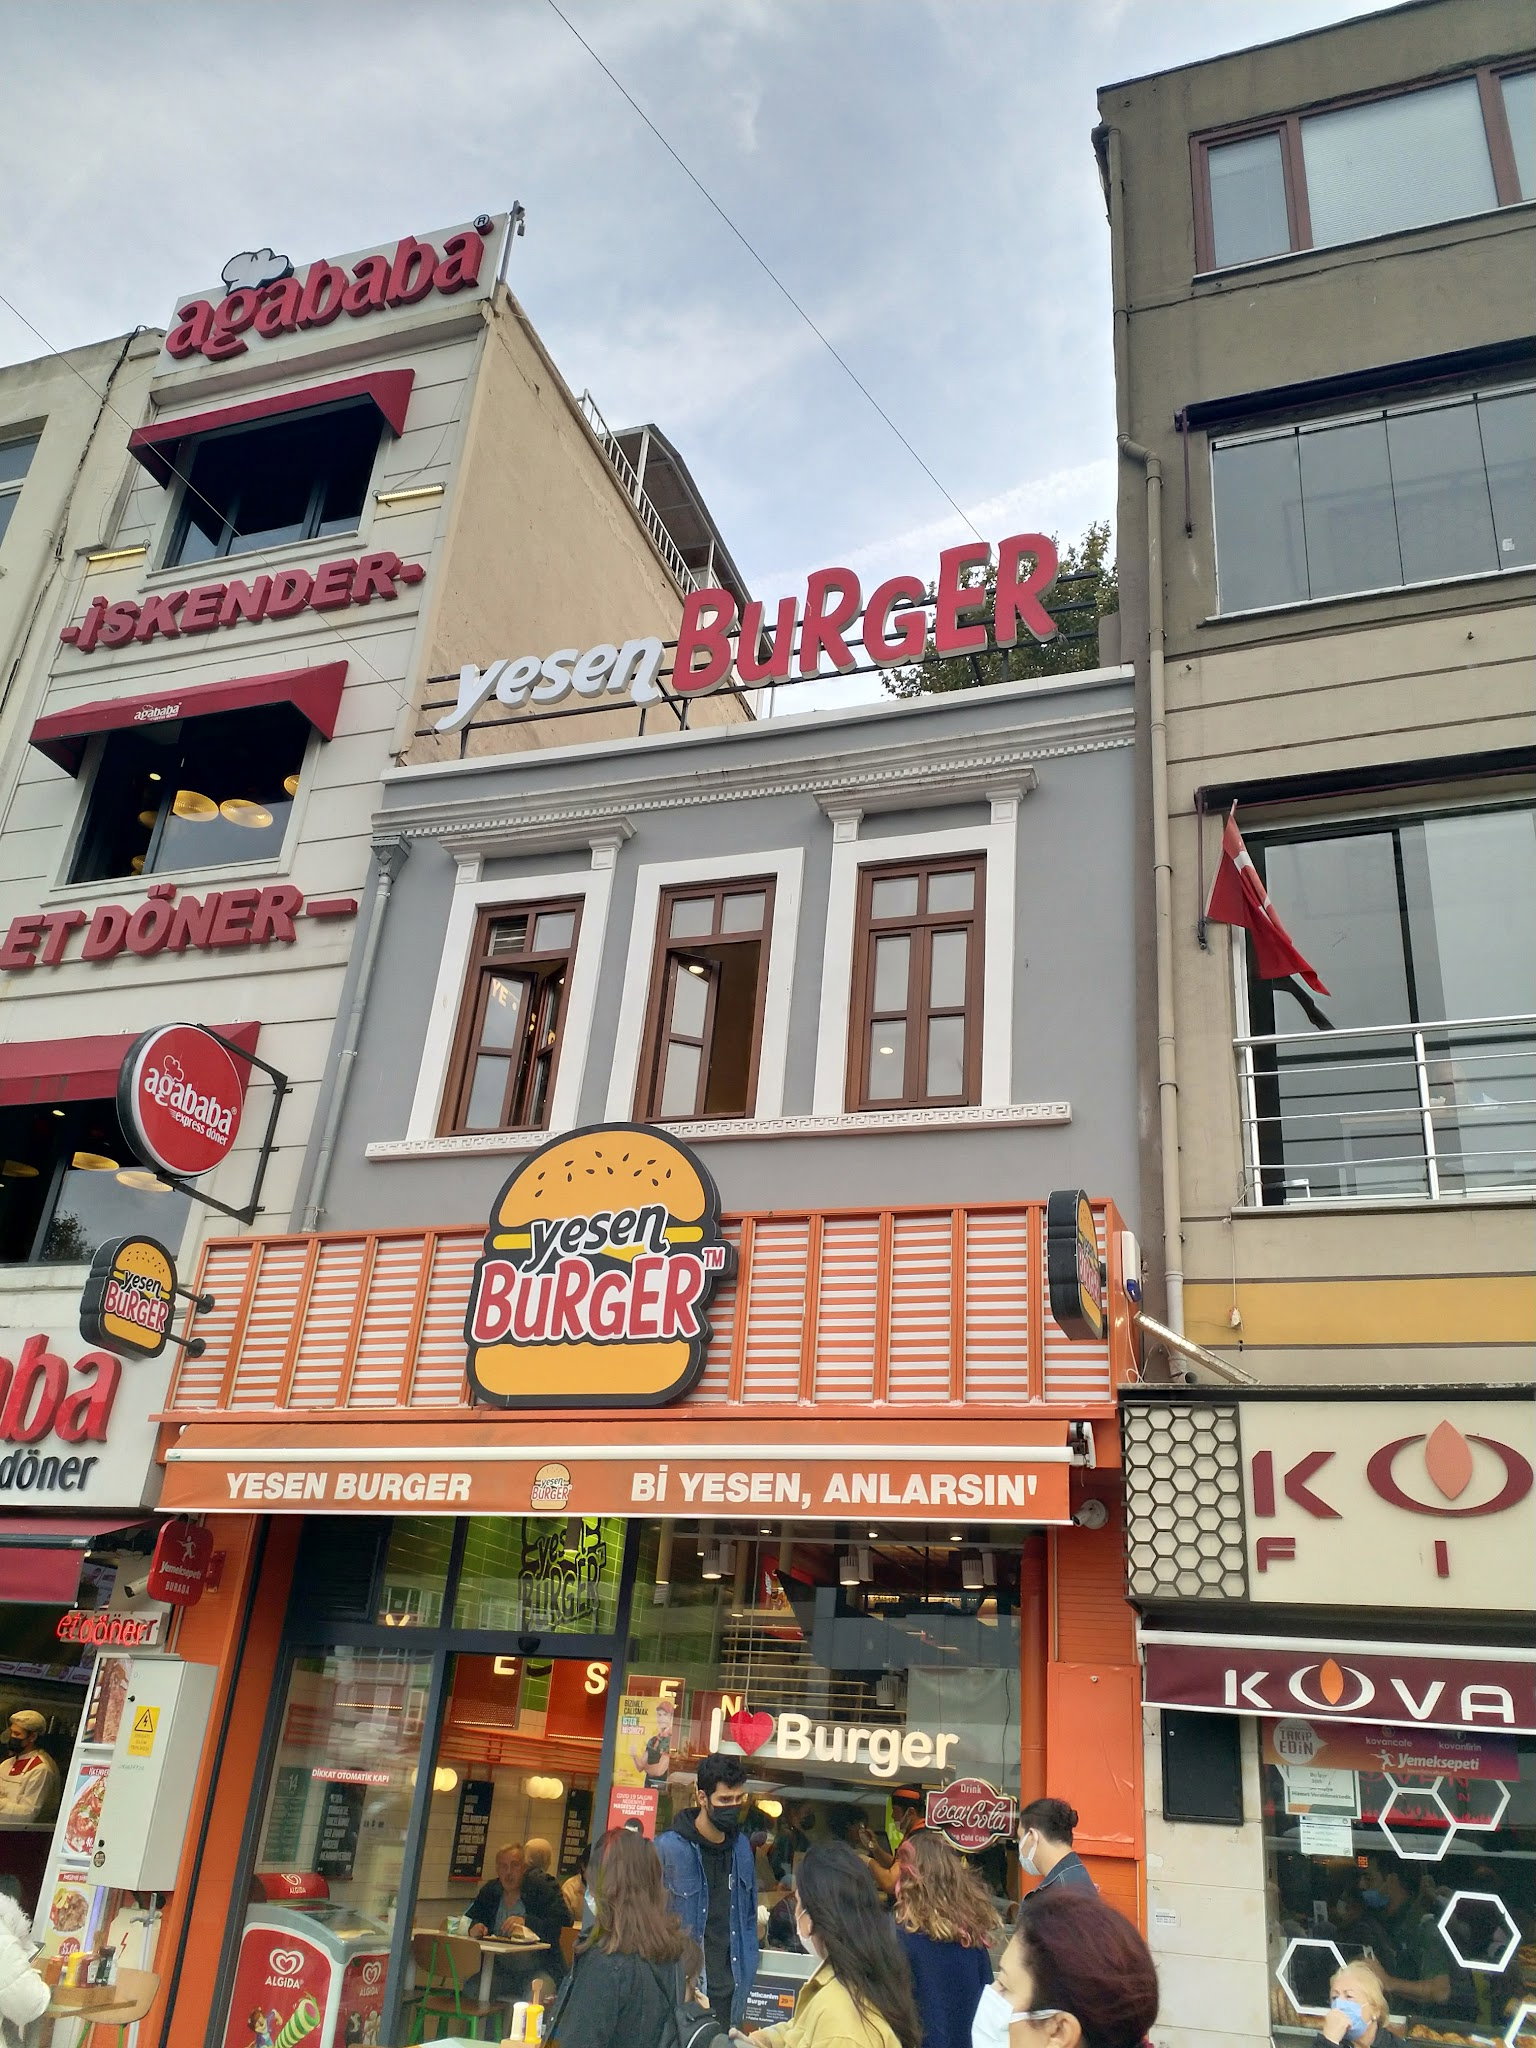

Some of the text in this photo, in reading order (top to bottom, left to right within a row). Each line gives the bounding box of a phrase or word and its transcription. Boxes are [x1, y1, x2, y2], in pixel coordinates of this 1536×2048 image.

[166, 229, 486, 361] agababa
[435, 534, 1059, 734] yesen BURGER
[0, 909, 87, 970] ET
[144, 1067, 232, 1135] agababa
[175, 1110, 228, 1146] express döner
[521, 1204, 671, 1273] yesen
[121, 1270, 161, 1299] yesen
[473, 1256, 702, 1340] BURGER
[104, 1281, 169, 1333] BURGER
[0, 1334, 122, 1444] ba
[0, 1449, 98, 1492] döner
[227, 1472, 472, 1501] YESEN BURGER
[540, 1478, 563, 1488] yesen
[631, 1465, 1037, 1509] Bİ YESEN, ANLARSIN'
[532, 1487, 569, 1500] BURGER
[776, 1713, 961, 1777] Burger
[1280, 1741, 1314, 1756] EDİN
[1397, 1753, 1480, 1771] Yemeksepeti
[311, 1768, 390, 1783] DİKKAT OTOMATİK KAPI
[960, 1784, 982, 1794] Drink
